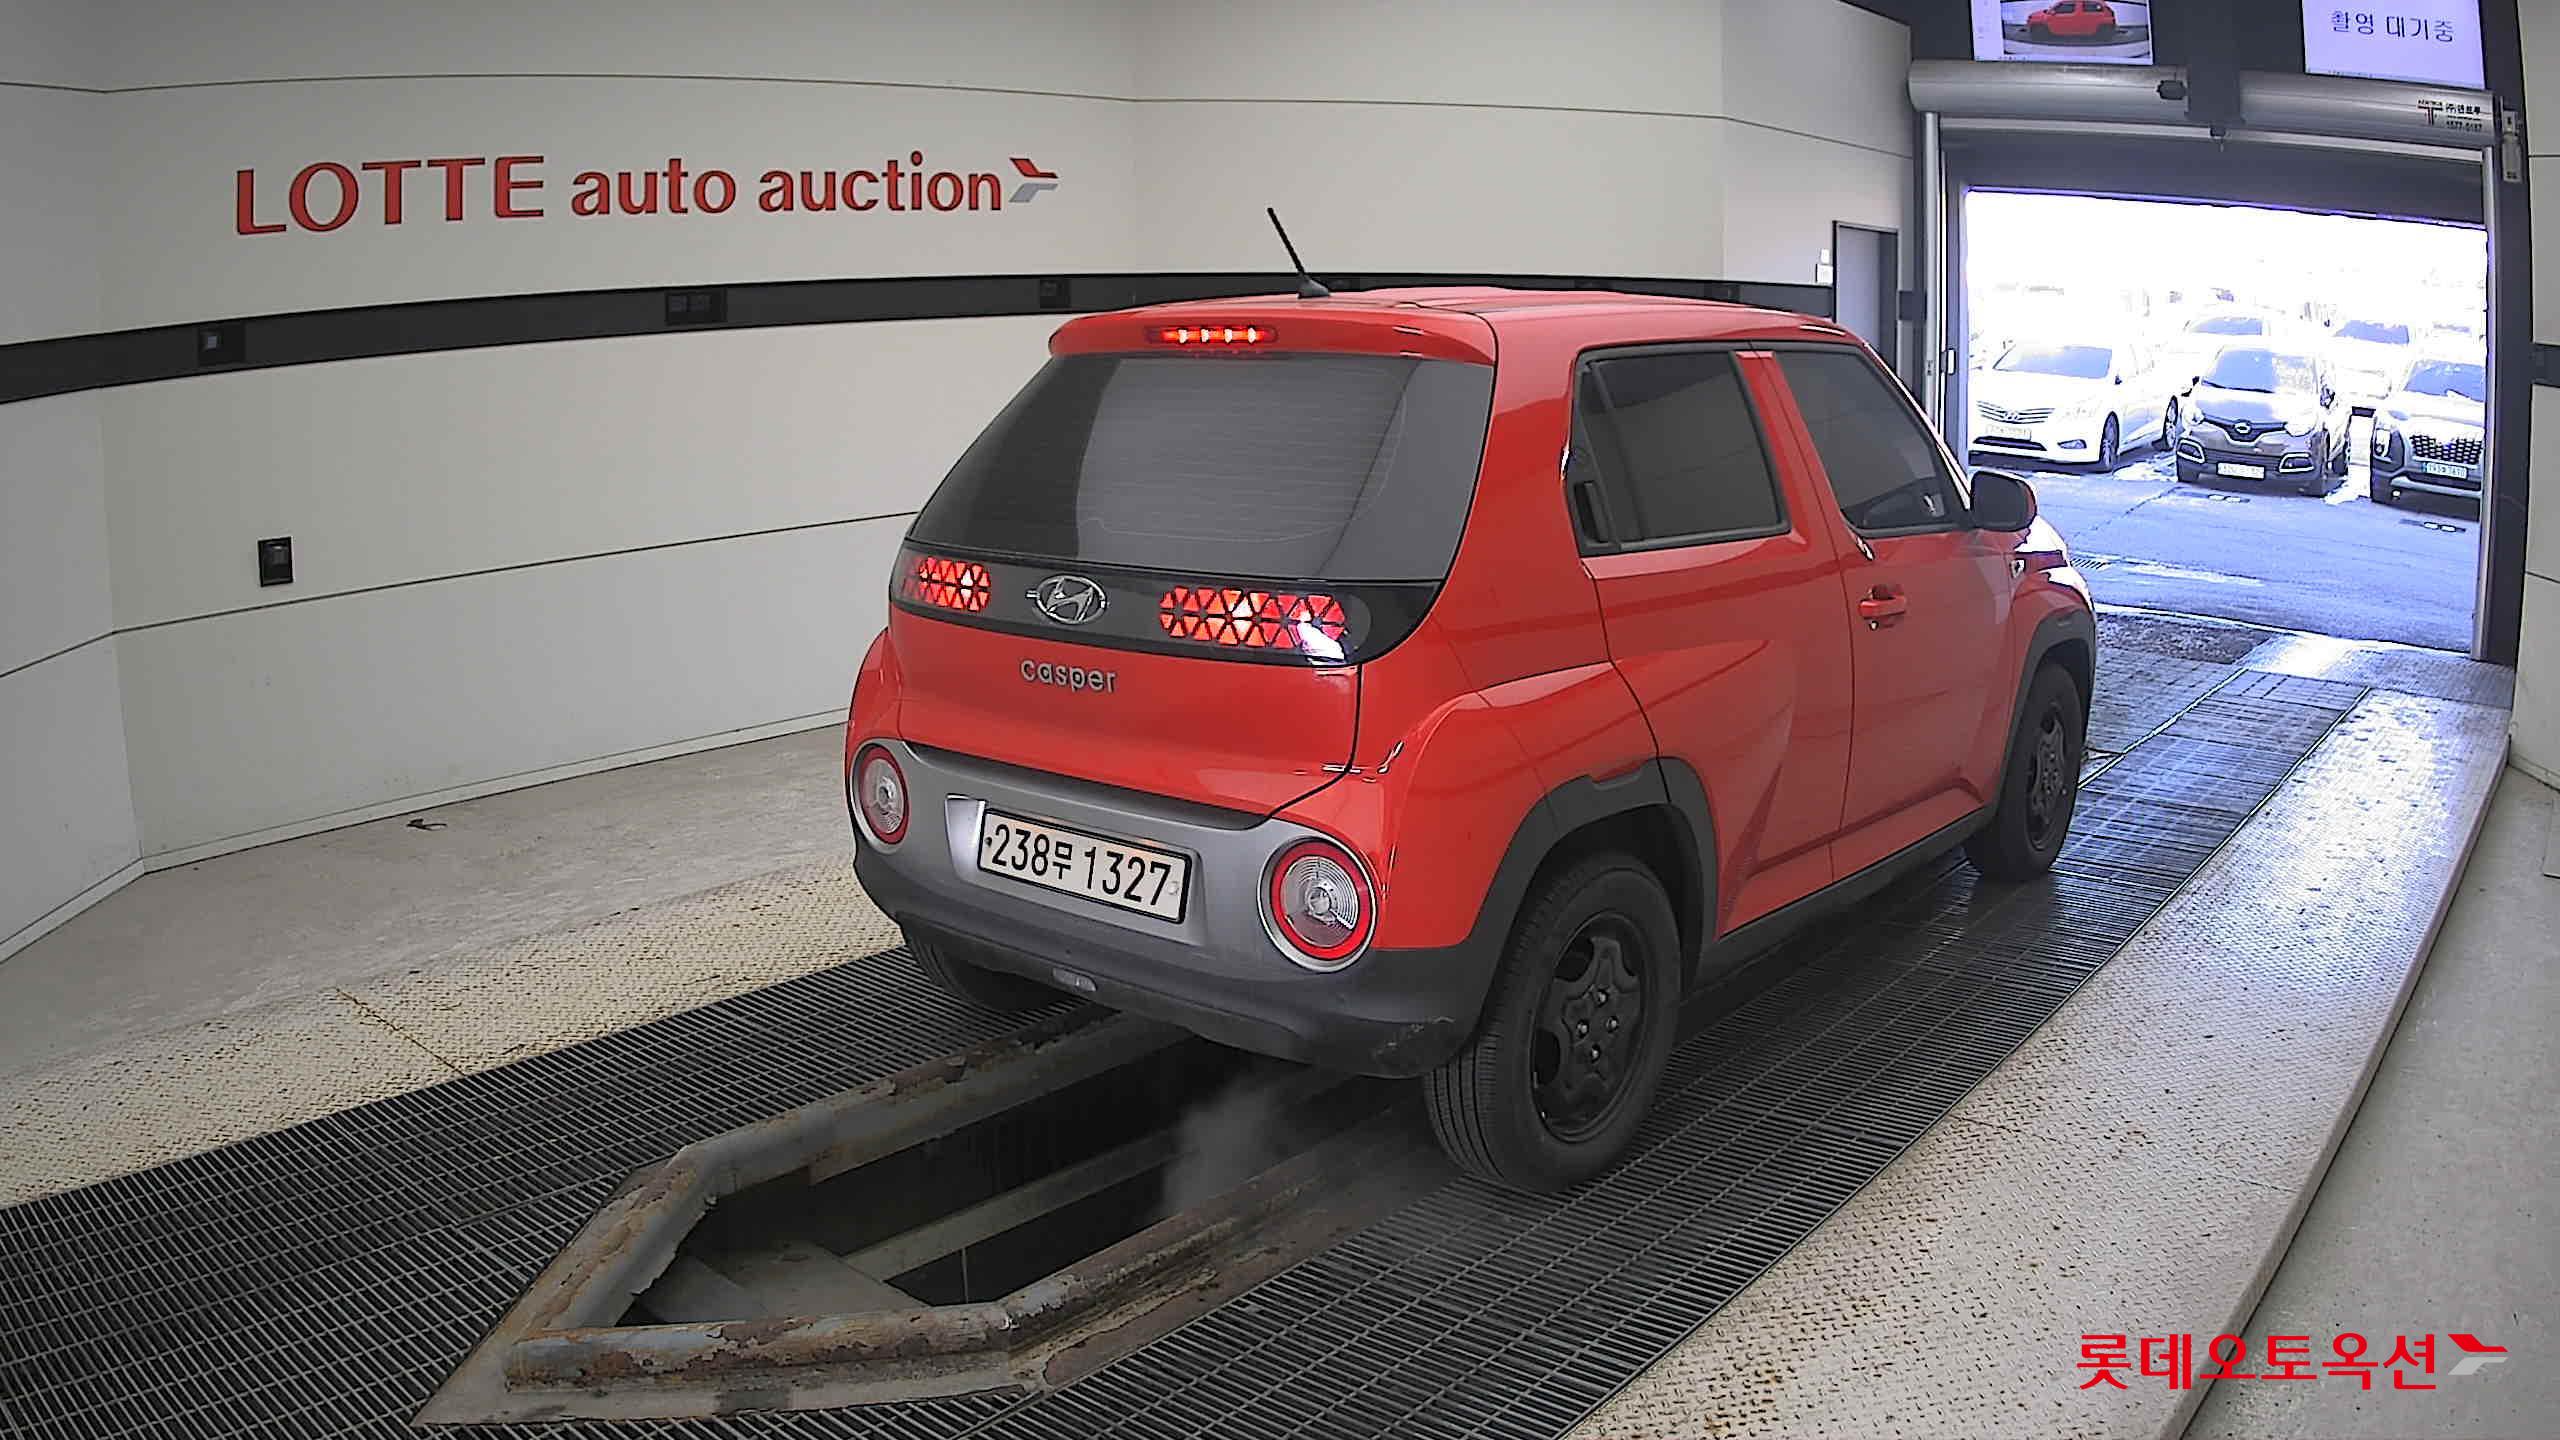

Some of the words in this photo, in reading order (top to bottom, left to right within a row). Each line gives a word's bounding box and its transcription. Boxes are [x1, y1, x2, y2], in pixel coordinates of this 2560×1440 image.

[236, 155, 545, 235] LOTTE
[571, 158, 737, 216] auto
[759, 151, 1003, 212] auction
[1021, 659, 1116, 693] casper
[992, 824, 1073, 879] 238무
[1084, 846, 1172, 905] 1327
